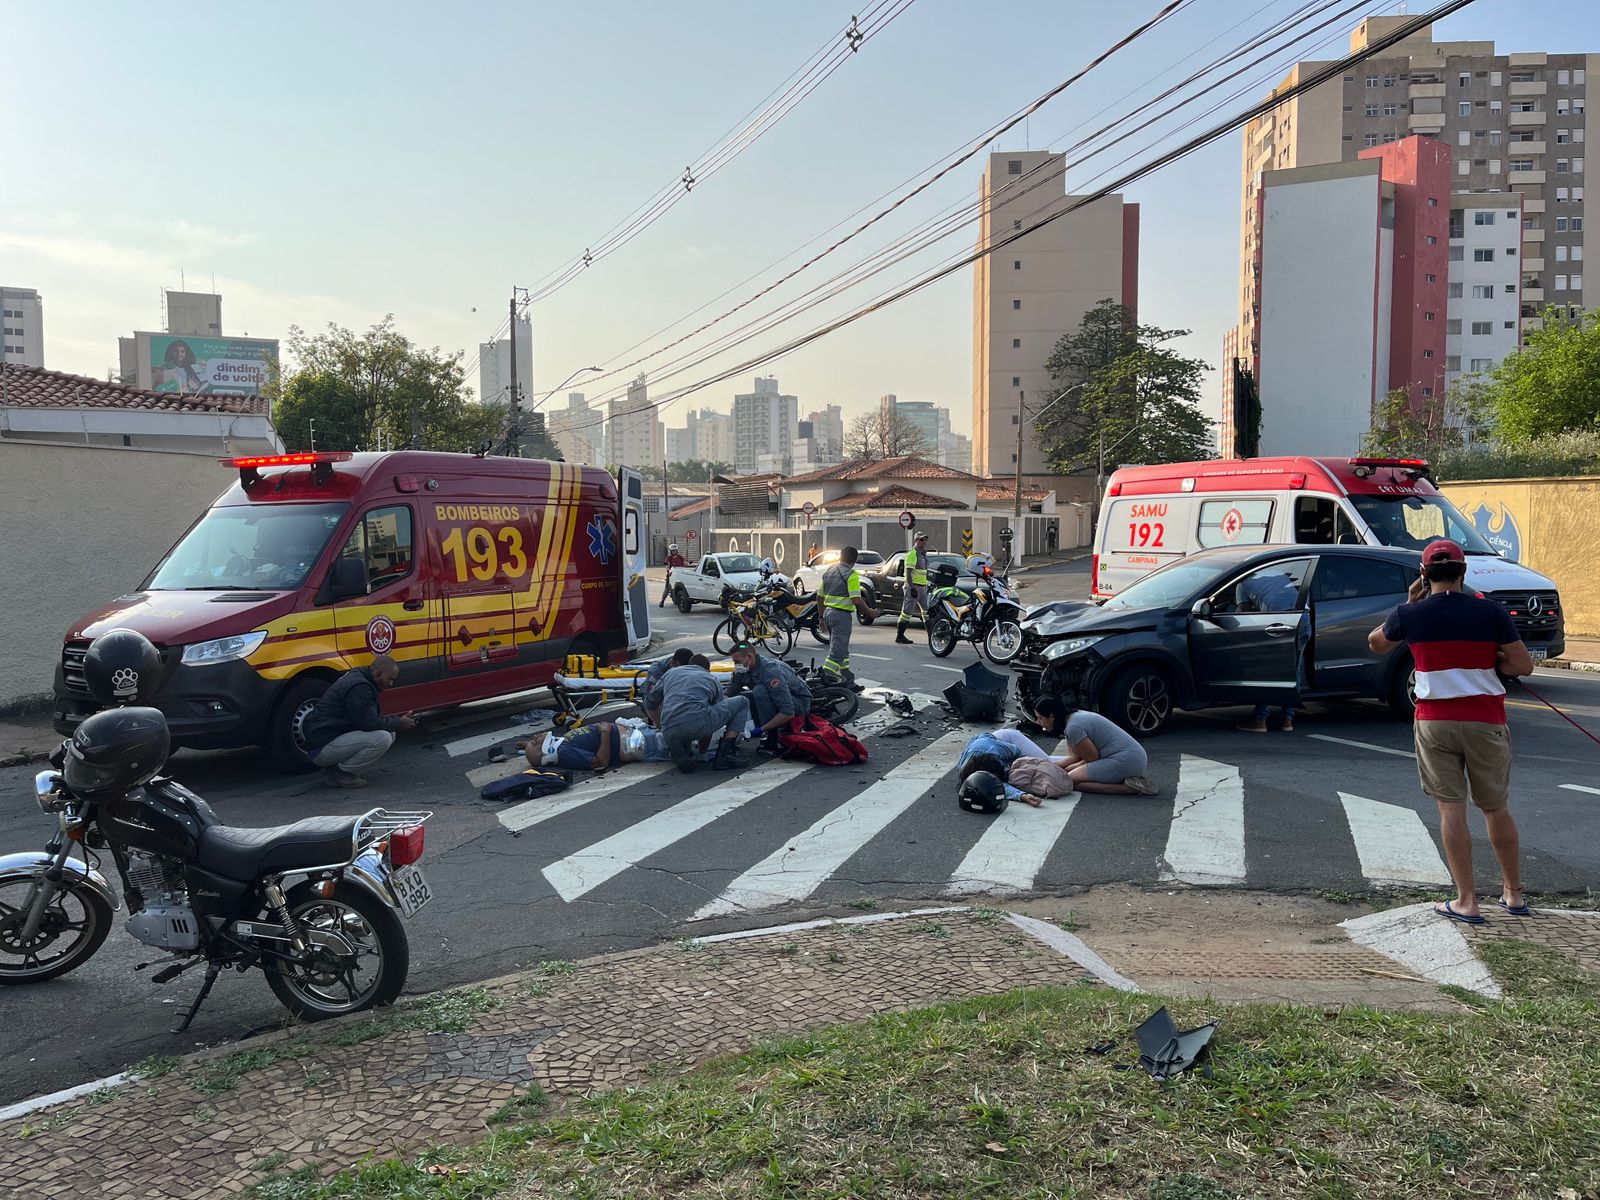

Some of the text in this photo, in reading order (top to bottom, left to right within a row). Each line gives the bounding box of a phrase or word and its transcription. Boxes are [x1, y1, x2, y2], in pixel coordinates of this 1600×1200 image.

[216, 363, 260, 374] dindim
[213, 372, 265, 383] de volta
[435, 505, 520, 521] BOMBEIROS
[1130, 503, 1169, 519] SAMU
[1129, 522, 1165, 548] 192
[1489, 535, 1513, 551] CIÊNCIA
[442, 526, 527, 582] 193
[1127, 556, 1159, 565] CAMPINAS
[581, 582, 598, 590] CORPO
[1099, 583, 1113, 591] B-04
[405, 884, 431, 914] 1992
